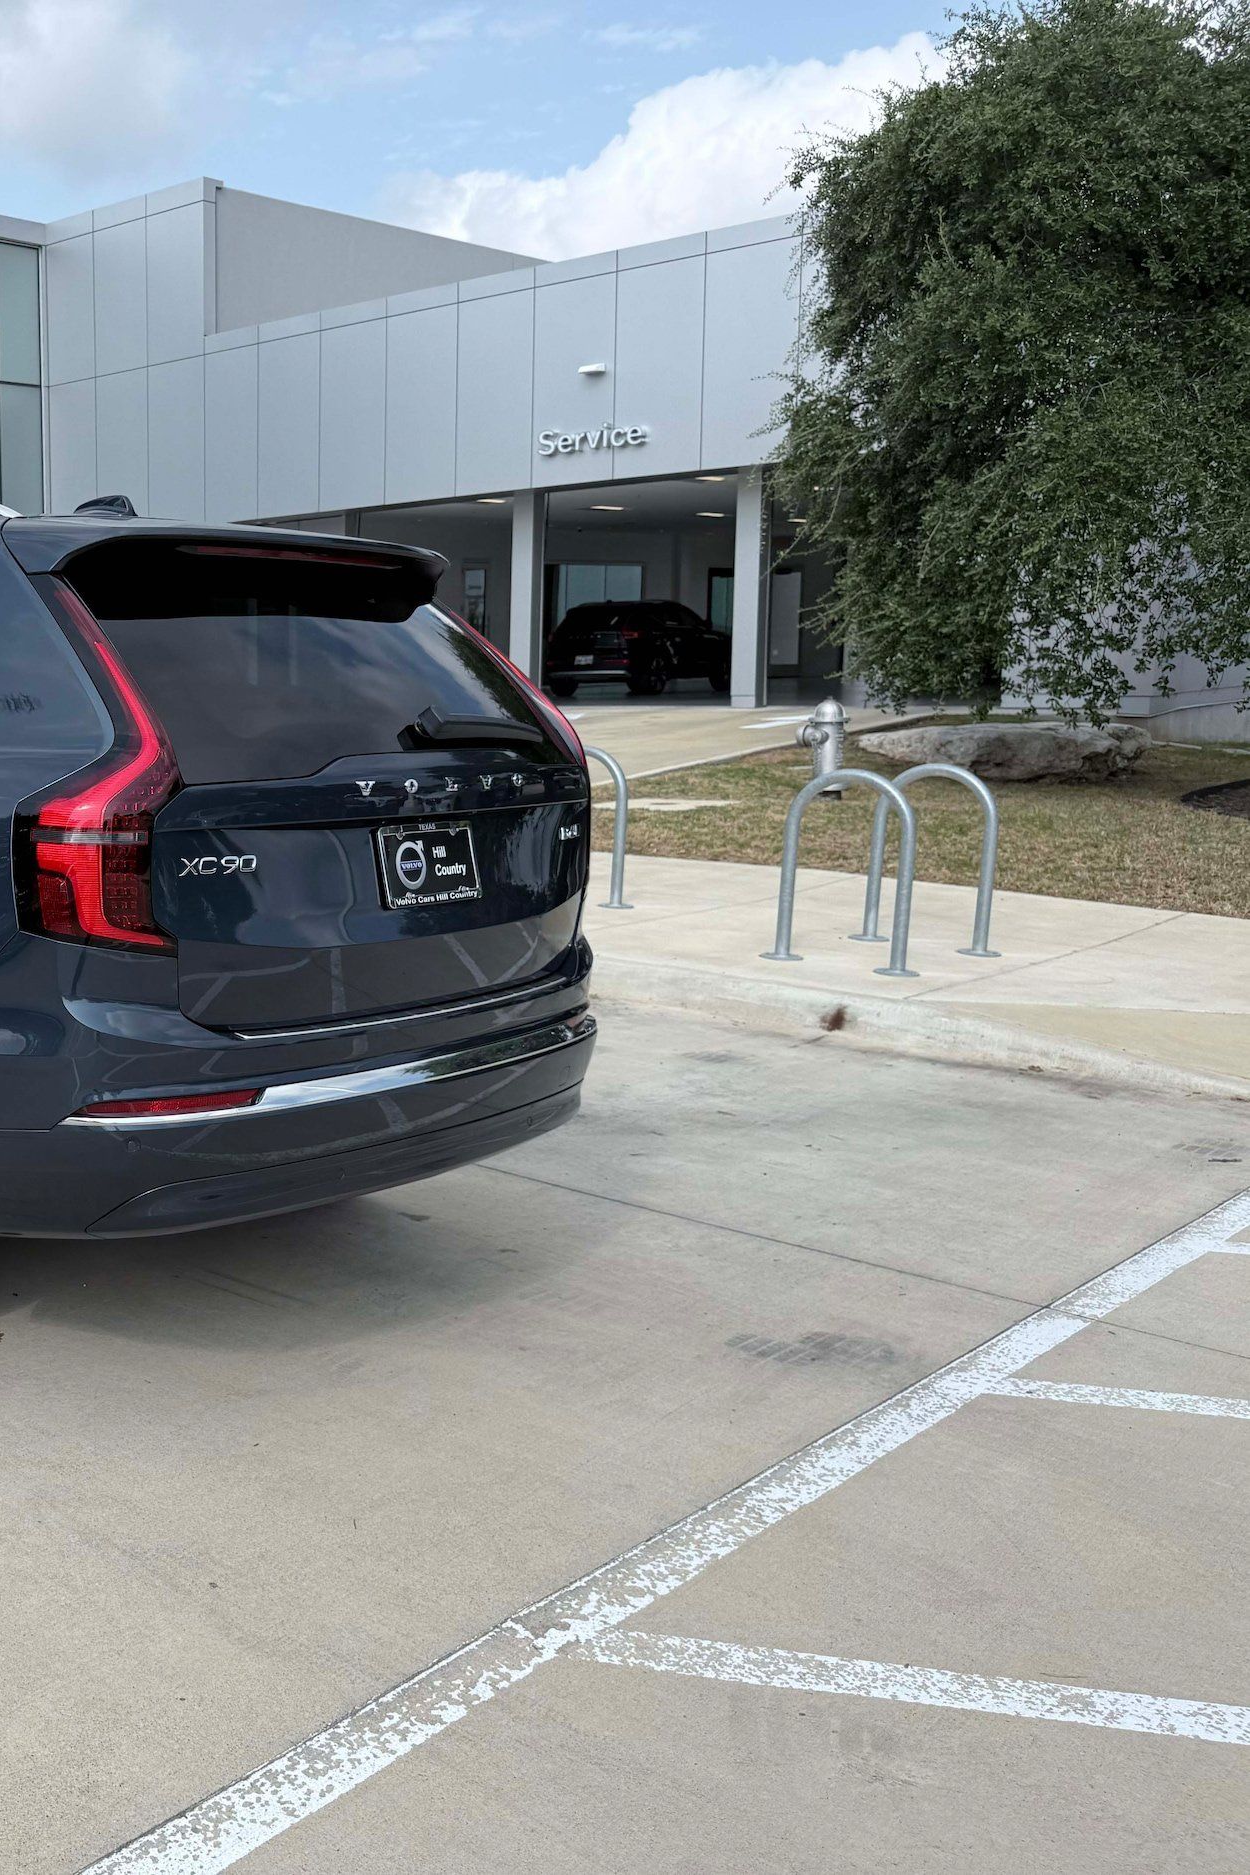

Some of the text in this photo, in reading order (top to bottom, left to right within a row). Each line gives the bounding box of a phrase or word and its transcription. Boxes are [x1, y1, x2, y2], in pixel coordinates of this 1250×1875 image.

[538, 422, 644, 456] Service
[355, 772, 524, 796] VOLVO
[418, 822, 436, 831] TEXAS
[432, 845, 447, 858] Hill
[178, 854, 257, 877] XC90
[401, 861, 423, 870] VOLVO
[434, 862, 467, 877] Country
[395, 889, 478, 906] Volvo Cars Hill Country
